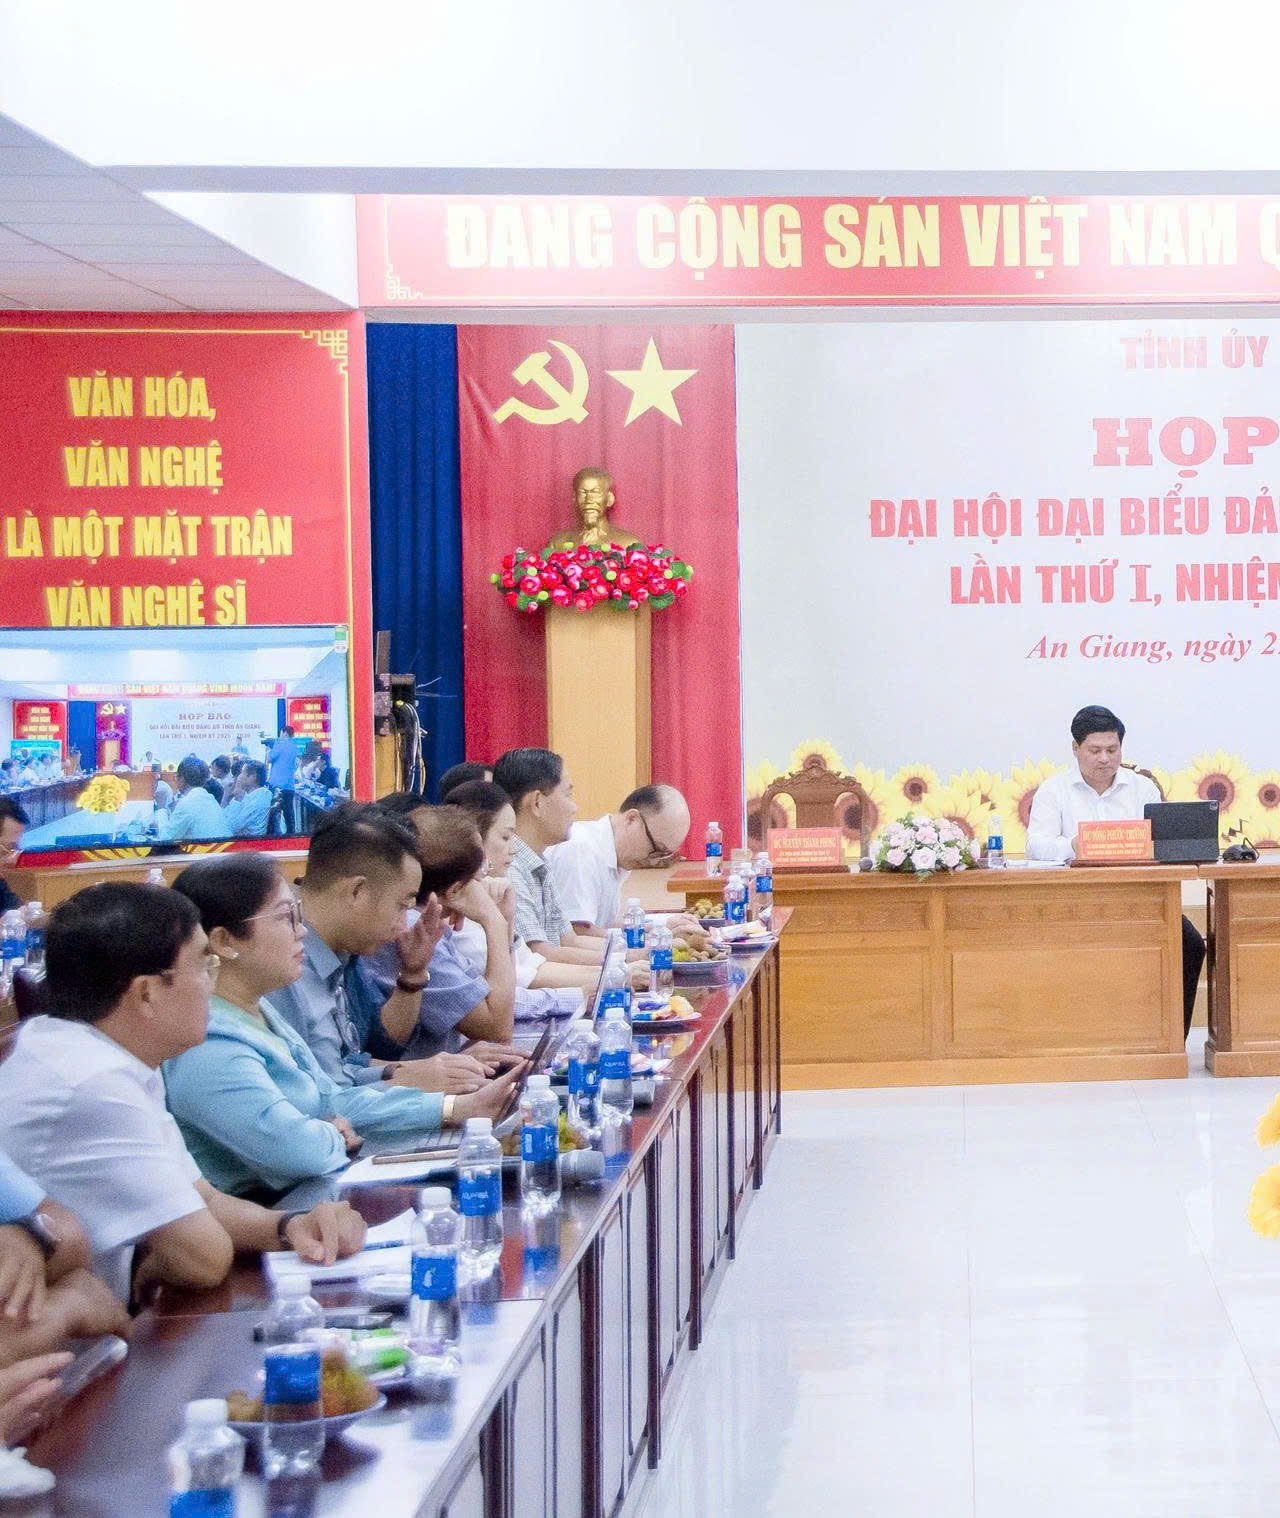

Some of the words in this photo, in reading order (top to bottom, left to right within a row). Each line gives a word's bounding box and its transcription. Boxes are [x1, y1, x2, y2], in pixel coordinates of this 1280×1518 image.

[636, 197, 802, 281] CỘNG
[960, 196, 1087, 279] VIỆT
[1110, 202, 1236, 267] NAM
[1120, 328, 1208, 372] TỈNH
[1221, 334, 1269, 369] ỦY
[69, 371, 133, 416] VĂN
[144, 372, 216, 421] HÓA,
[64, 440, 128, 486] VĂN
[140, 440, 223, 494] NGHỆ
[1093, 416, 1280, 478] HỌP
[5, 511, 43, 557] LÀ
[52, 510, 123, 564] MỘT
[133, 509, 202, 564] MẶT
[209, 508, 292, 564] TRẬN
[869, 498, 938, 546] ĐẠI
[952, 492, 1022, 544] HỘI
[1037, 498, 1104, 544] ĐẠI
[1120, 486, 1211, 536] BIỂU
[46, 581, 110, 626] VĂN
[214, 579, 246, 625] SĨ
[949, 553, 1021, 605] LẦN
[1034, 559, 1120, 605] THỨ
[1130, 564, 1163, 605] I,
[1025, 634, 1068, 660] An
[1079, 634, 1173, 664] Giang,
[1184, 632, 1253, 663] ngày
